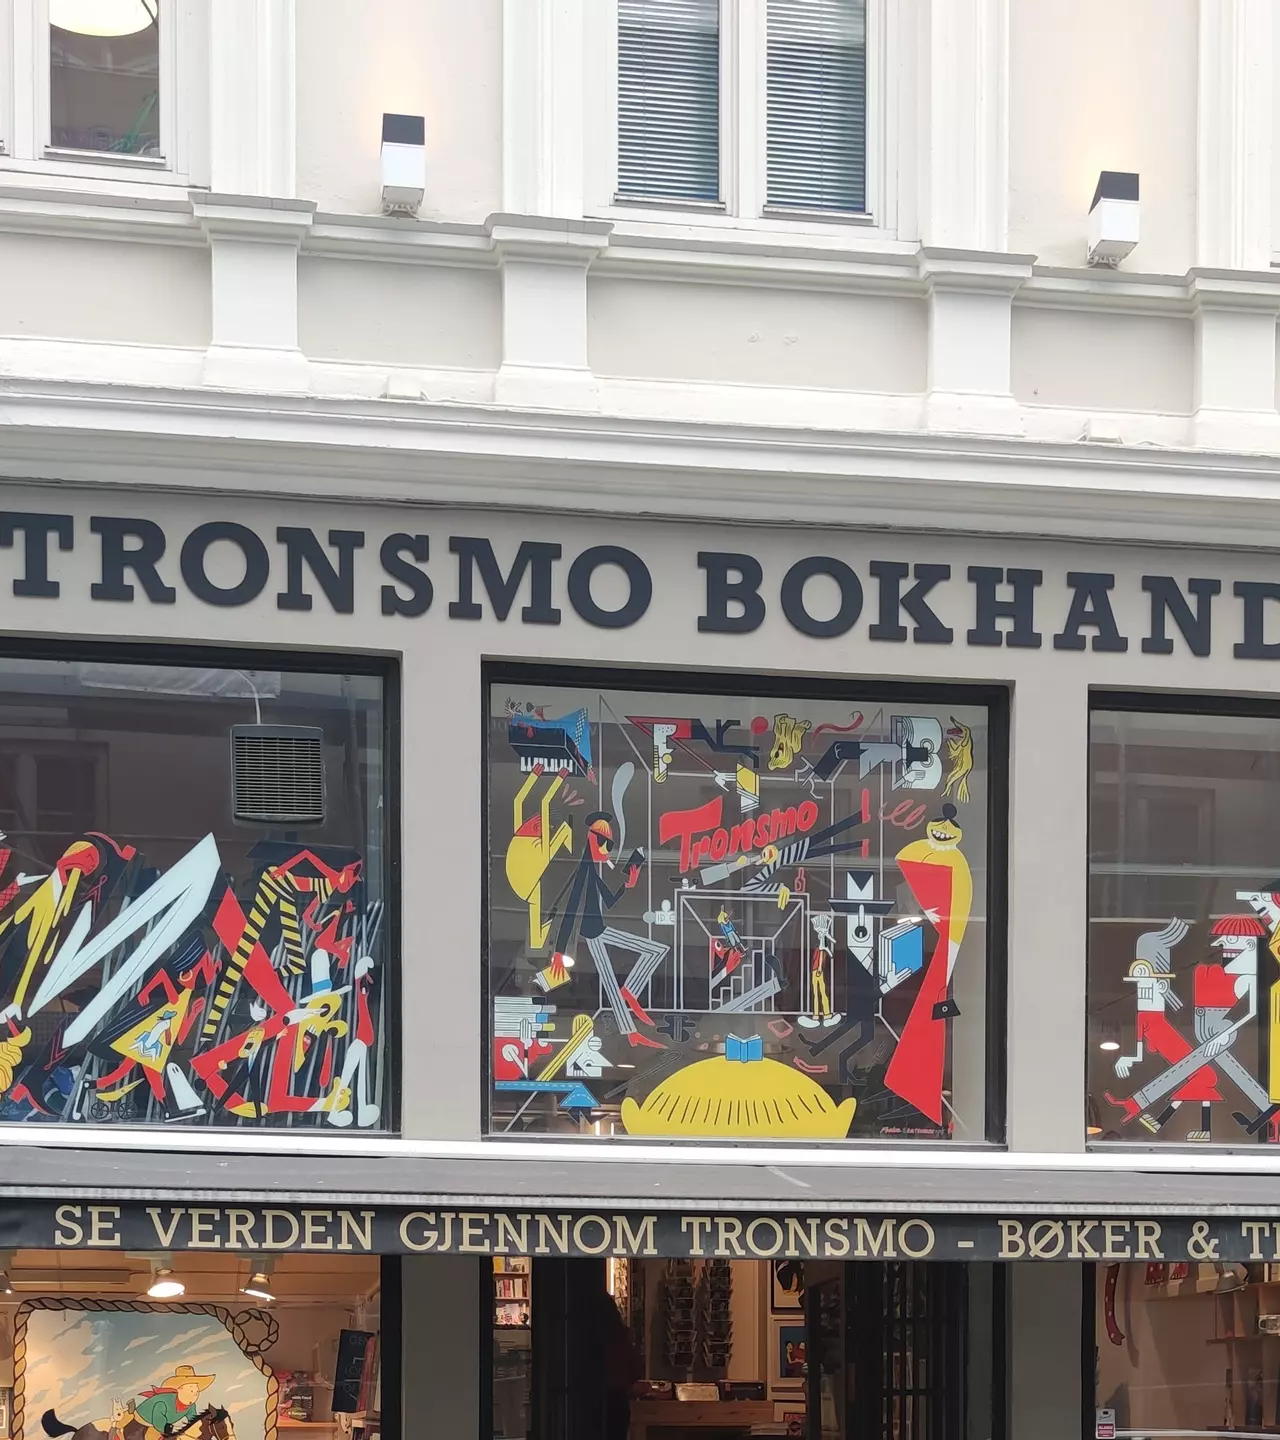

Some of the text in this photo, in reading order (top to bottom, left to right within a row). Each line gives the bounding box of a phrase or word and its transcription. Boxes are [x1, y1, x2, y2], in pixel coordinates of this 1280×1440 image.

[658, 795, 819, 874] Tronsmo
[54, 1205, 121, 1248] SE
[144, 1207, 375, 1251] VERDEN
[398, 1210, 659, 1256] GJENNOM
[680, 1215, 936, 1259] TRONSMO
[997, 1217, 1165, 1260] BØKER
[1186, 1219, 1220, 1260] &
